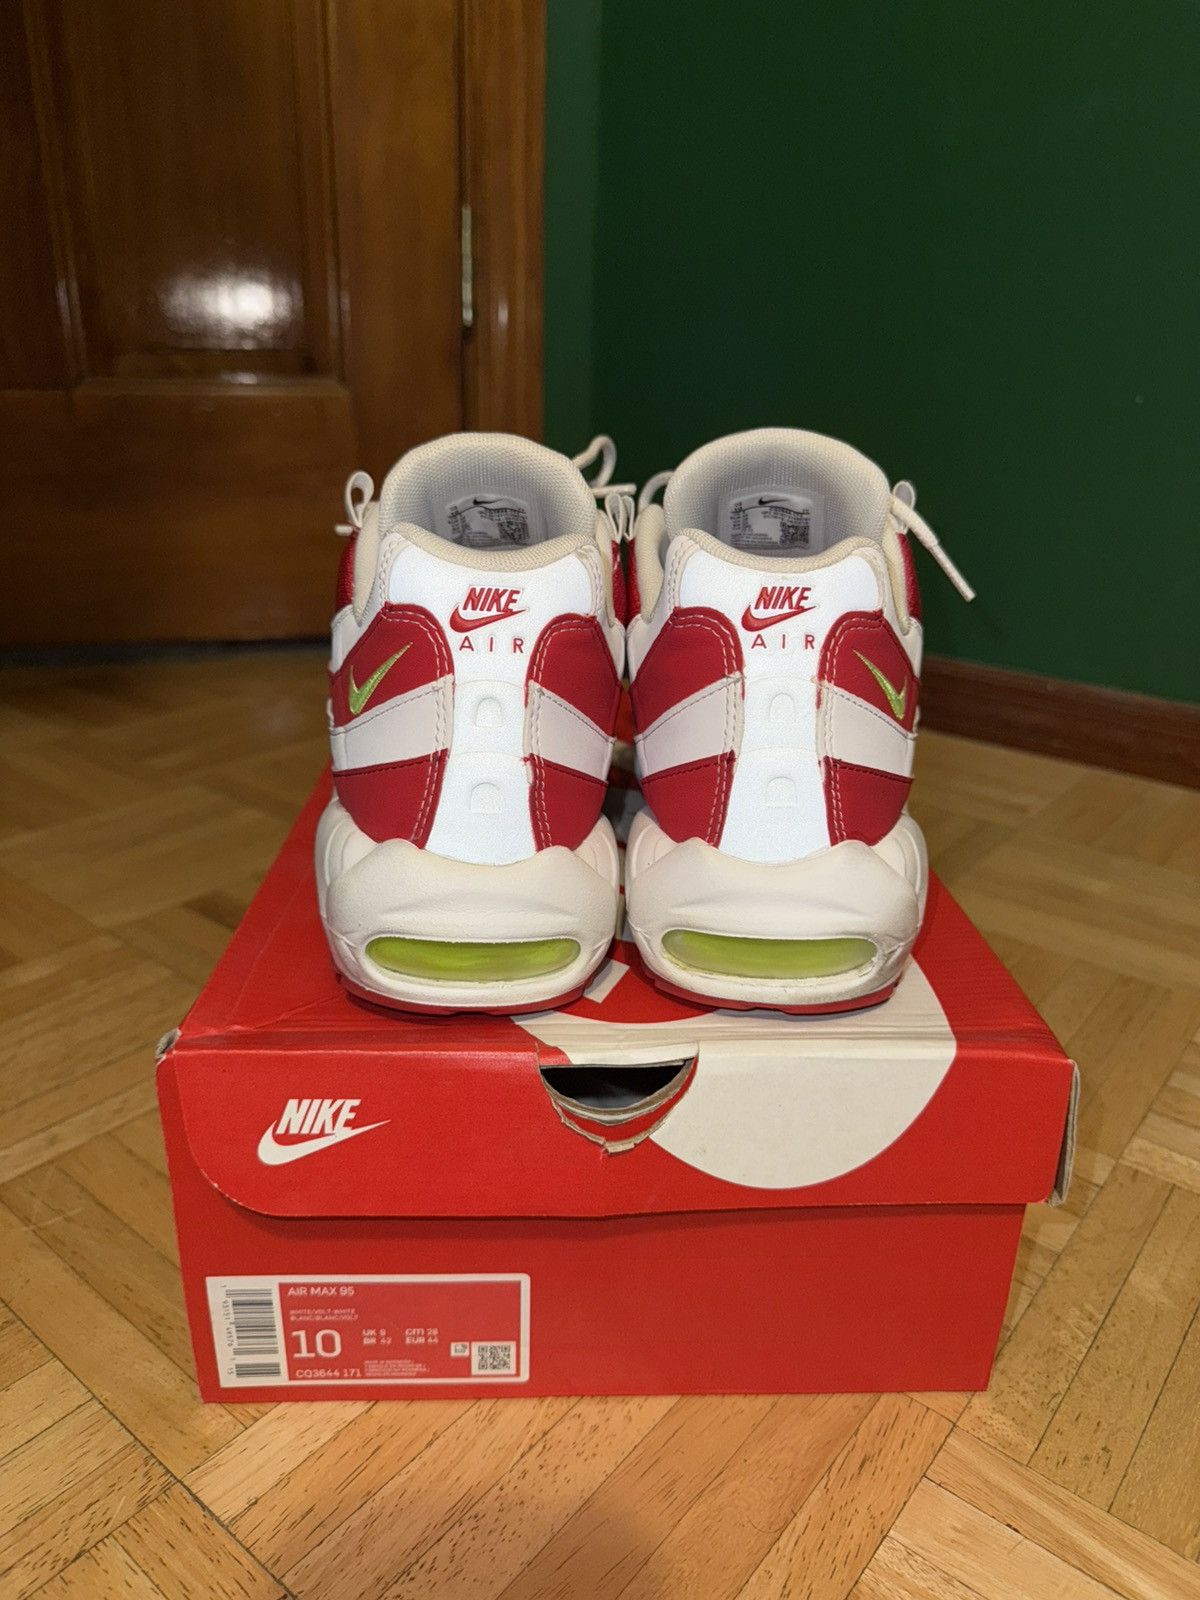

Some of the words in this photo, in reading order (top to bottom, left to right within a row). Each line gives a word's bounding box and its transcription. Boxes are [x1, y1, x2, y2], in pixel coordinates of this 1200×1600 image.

[463, 587, 520, 612] NIKE
[754, 586, 812, 610] NIKE
[459, 635, 524, 653] AIR
[751, 633, 815, 650] AIR
[275, 1098, 362, 1135] NIKE
[288, 1286, 308, 1296] AIR
[310, 1286, 337, 1296] MAX
[340, 1286, 355, 1296] 95
[291, 1329, 342, 1358] 10
[405, 1336, 425, 1344] EUR
[427, 1336, 439, 1344] 44
[343, 1368, 362, 1377] 171
